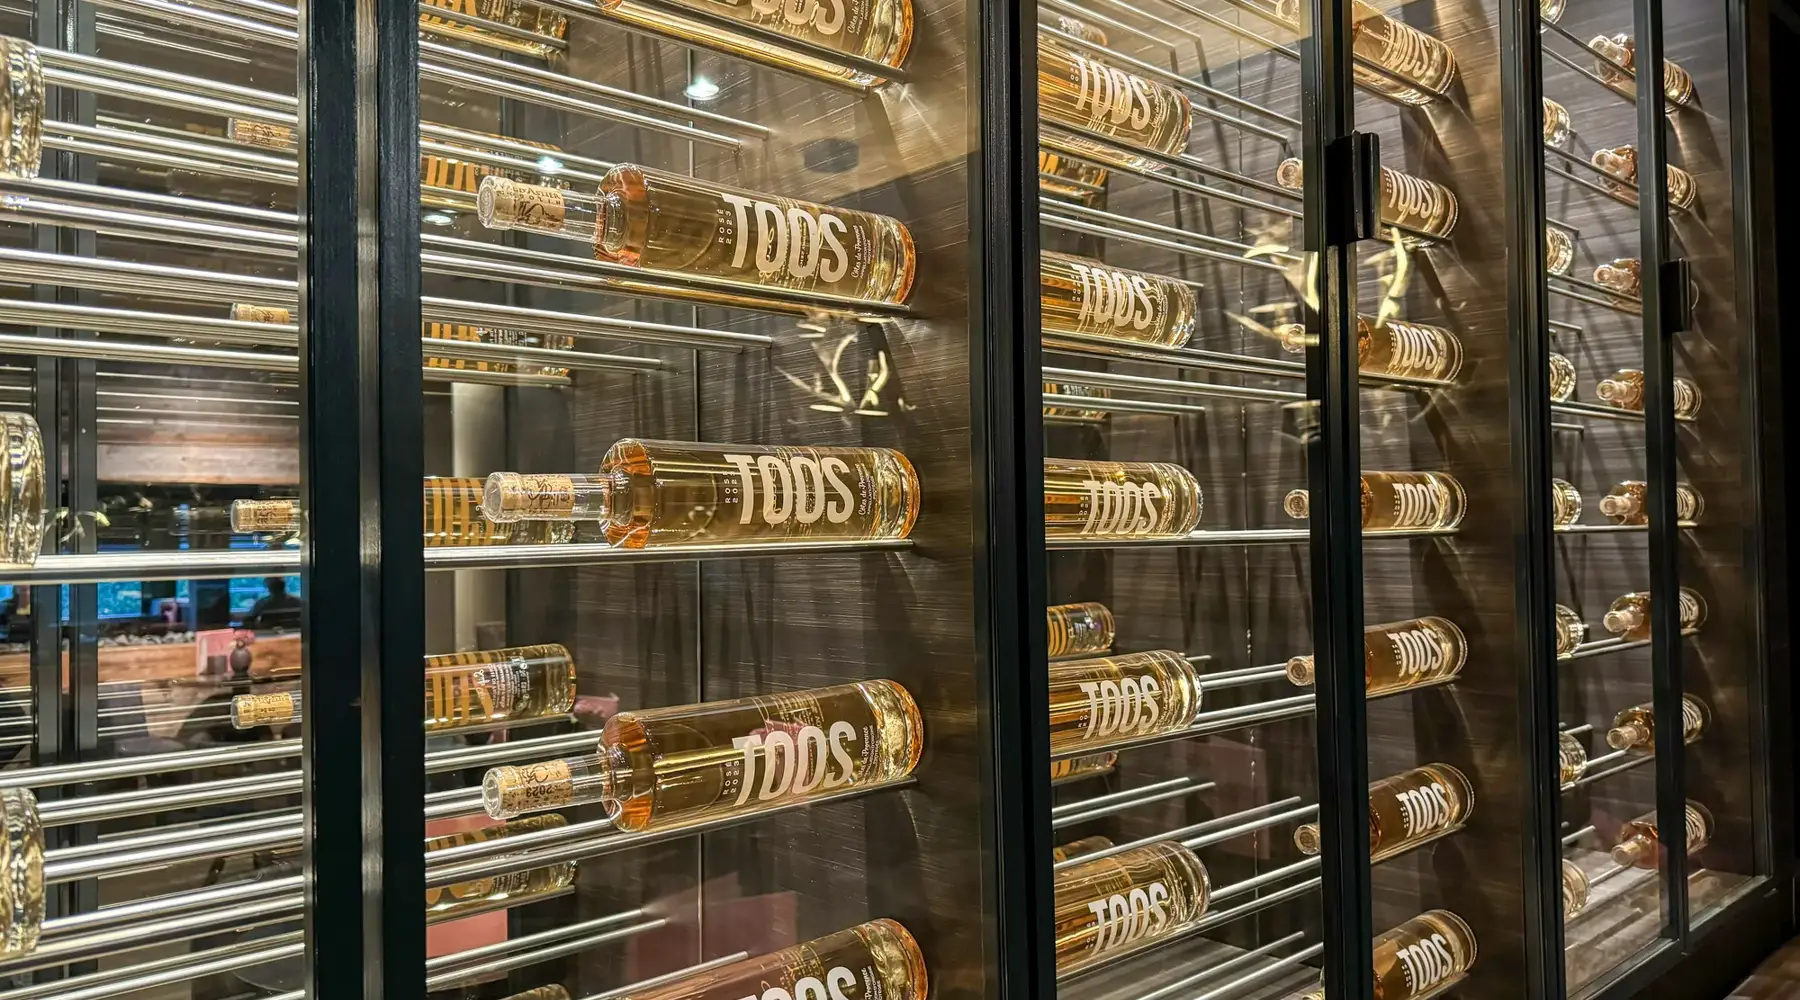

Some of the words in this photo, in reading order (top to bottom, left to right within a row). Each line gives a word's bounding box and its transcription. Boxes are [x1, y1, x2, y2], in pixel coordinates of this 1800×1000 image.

[1380, 15, 1430, 78] TOOS
[1068, 51, 1151, 130] TOOS
[1379, 165, 1434, 219] TOOS
[716, 208, 725, 244] ROSÉ
[721, 193, 849, 283] TOOS
[724, 210, 733, 245] 2023
[1069, 263, 1153, 330] TOOS
[1386, 322, 1438, 371] TOOS
[723, 454, 854, 525] TOOS
[1080, 480, 1162, 535] TOOS
[1392, 483, 1440, 528] TOOS
[1387, 628, 1442, 677] TOOS
[1078, 675, 1162, 740] TOOS
[730, 760, 740, 794] 2023
[732, 721, 857, 807] TOOS
[1395, 782, 1450, 838] TOOS
[1088, 882, 1168, 957] TOOS
[1396, 933, 1452, 996] TOOS
